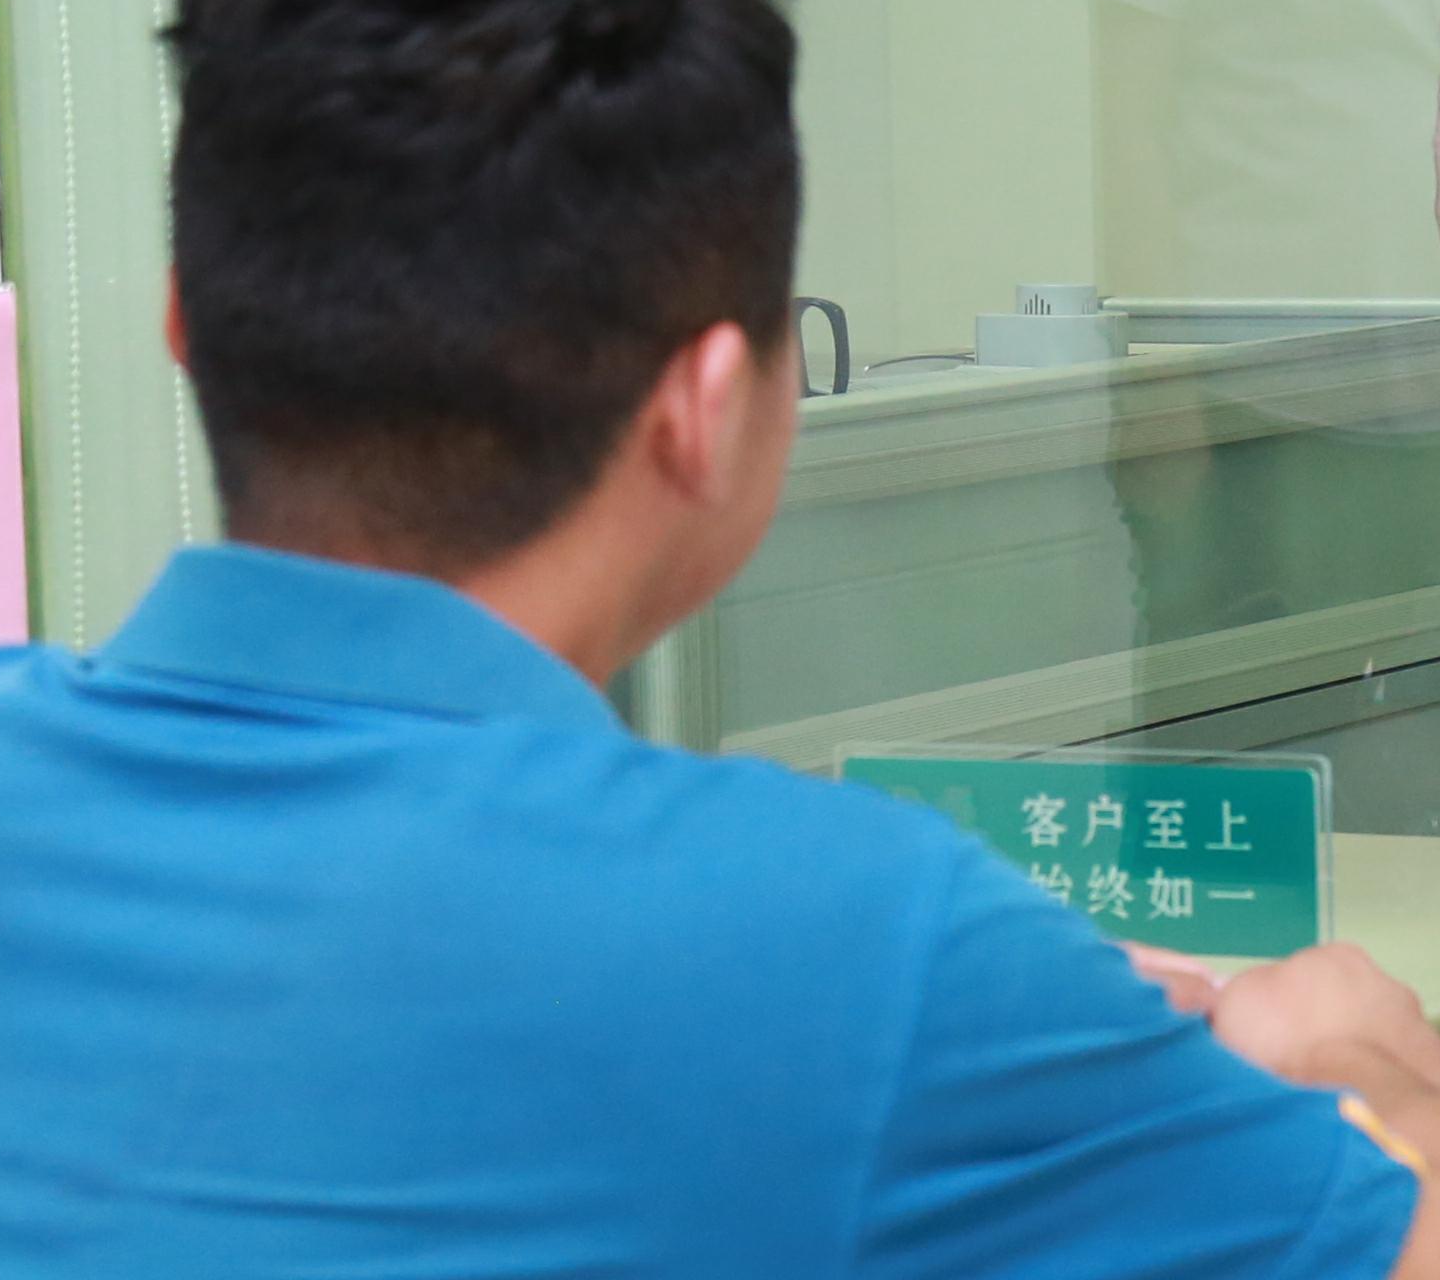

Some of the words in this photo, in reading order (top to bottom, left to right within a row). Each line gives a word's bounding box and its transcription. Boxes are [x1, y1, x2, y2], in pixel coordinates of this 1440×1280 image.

[1021, 792, 1252, 852] 客户至上
[1028, 862, 1257, 920] 始终如一
